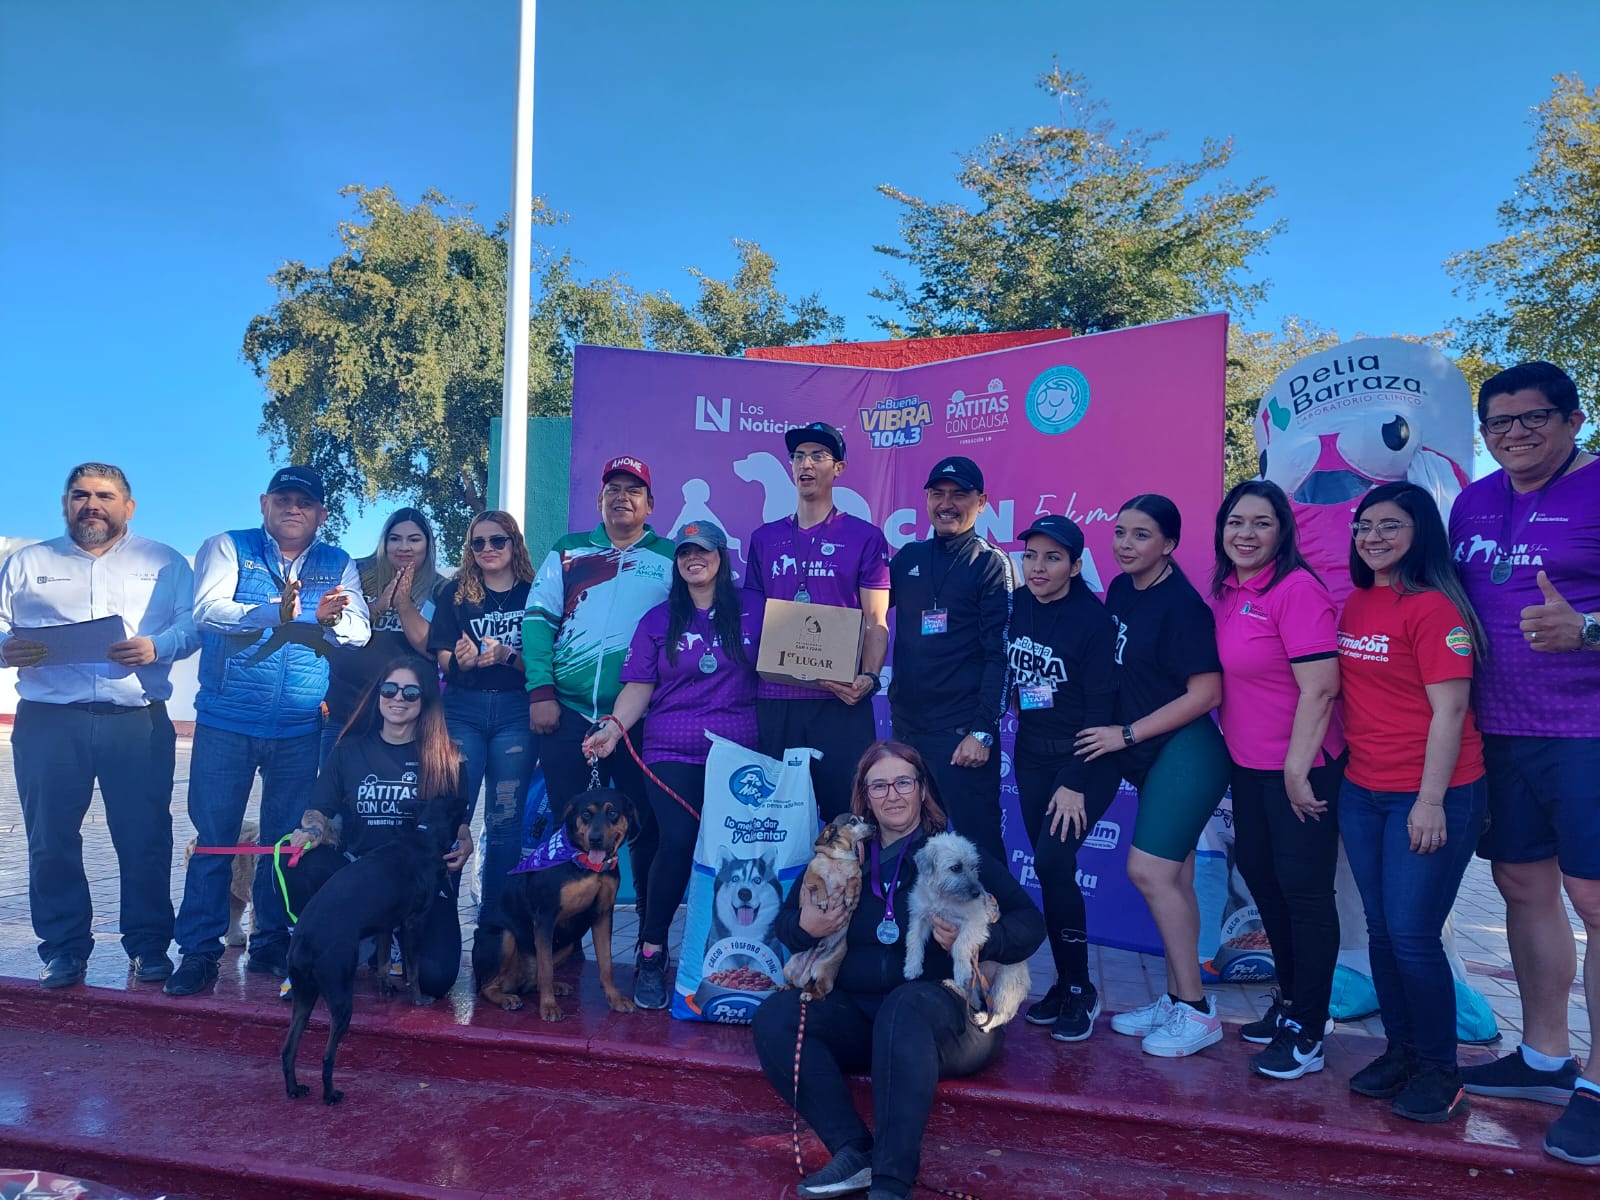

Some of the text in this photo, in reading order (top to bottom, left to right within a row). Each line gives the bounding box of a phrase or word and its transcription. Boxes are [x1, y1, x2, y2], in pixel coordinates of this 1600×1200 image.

[1289, 355, 1380, 398] Delia
[885, 396, 918, 409] Buena
[1293, 376, 1421, 415] Barraza
[740, 402, 764, 415] Los
[946, 395, 1010, 420] PATITAS
[861, 403, 932, 431] VIBRA
[945, 412, 1009, 434] CON CAUSA
[871, 427, 921, 447] 104.3
[611, 457, 642, 473] AHOME
[796, 656, 833, 670] LUGAR
[1362, 654, 1389, 663] precio
[357, 801, 378, 814] CON
[708, 948, 723, 968] CALCIO
[766, 957, 778, 975] ZINC
[713, 1004, 747, 1018] Pet
